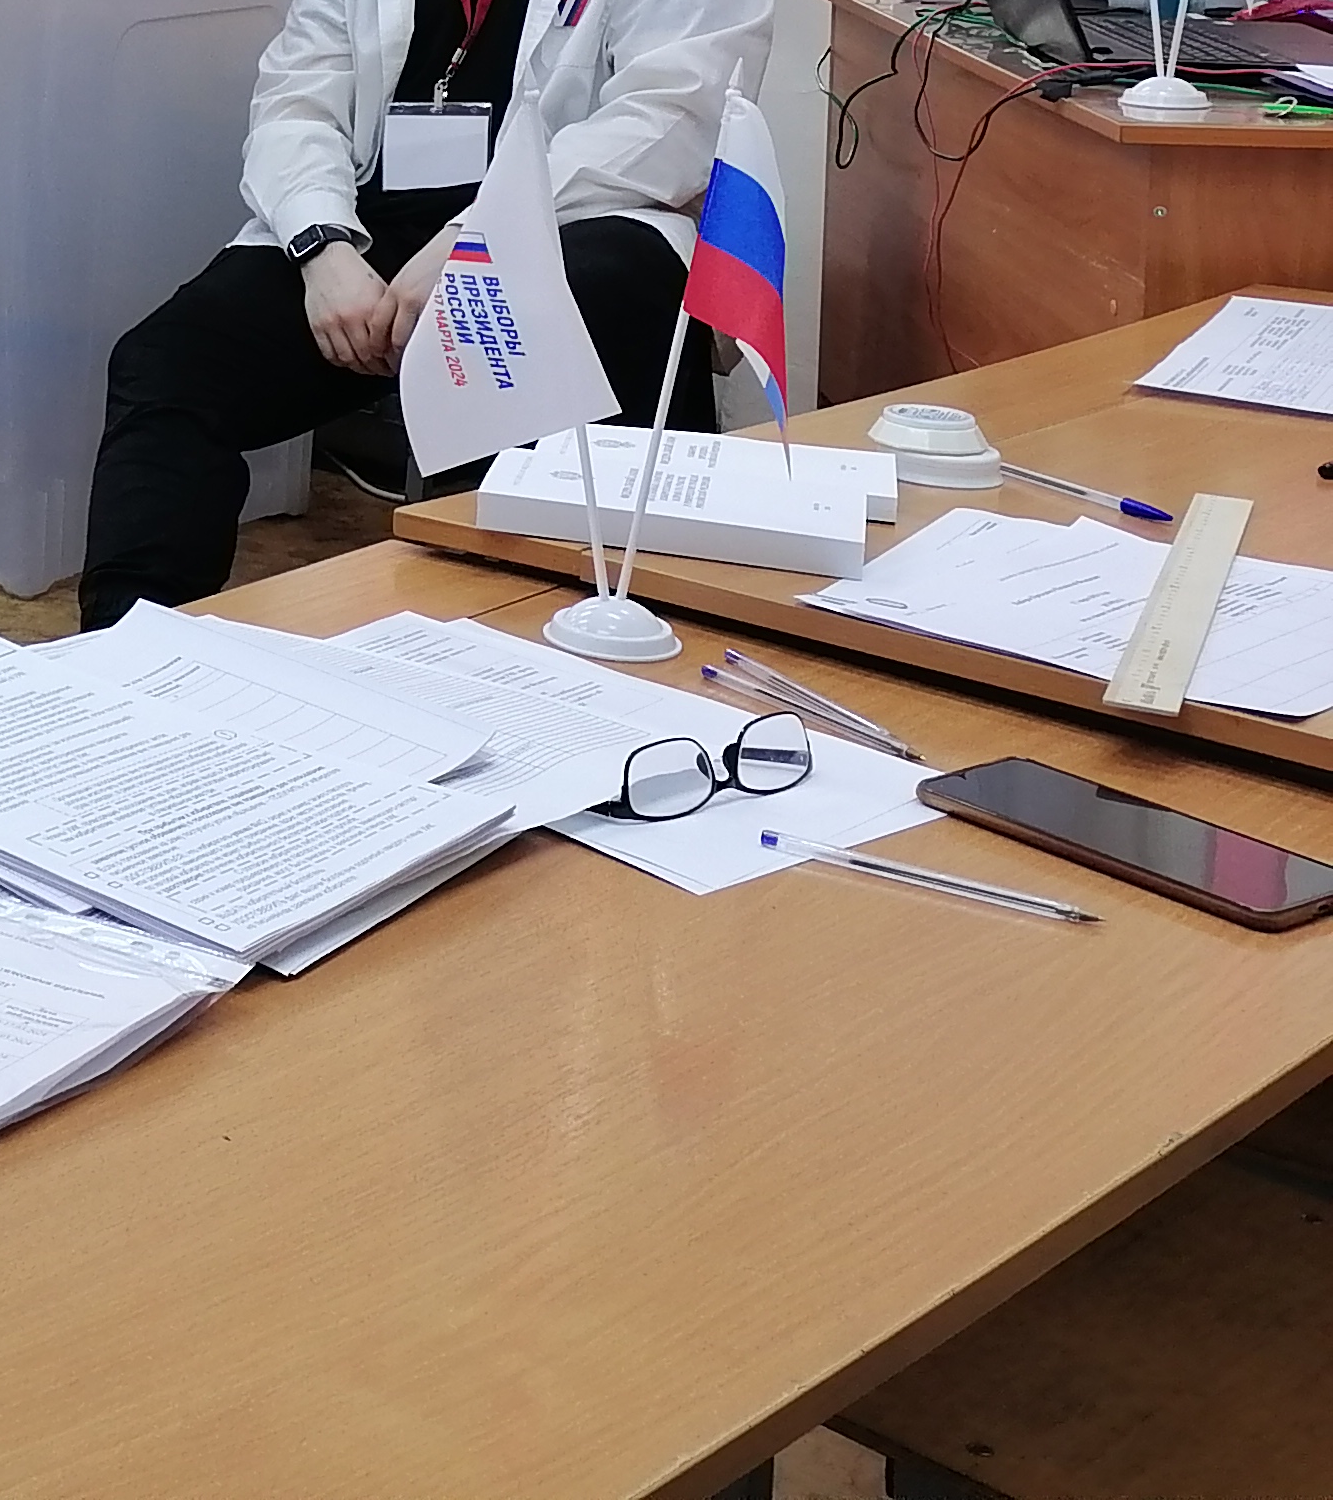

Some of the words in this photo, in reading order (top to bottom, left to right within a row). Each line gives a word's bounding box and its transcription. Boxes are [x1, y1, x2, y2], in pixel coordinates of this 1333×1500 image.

[435, 308, 454, 353] МАРТА
[445, 352, 466, 388] 2024
[444, 272, 475, 345] РОССИИ
[460, 274, 514, 390] ПРЕЗИДЕНТА
[482, 275, 527, 357] ВЫБОРЫ
